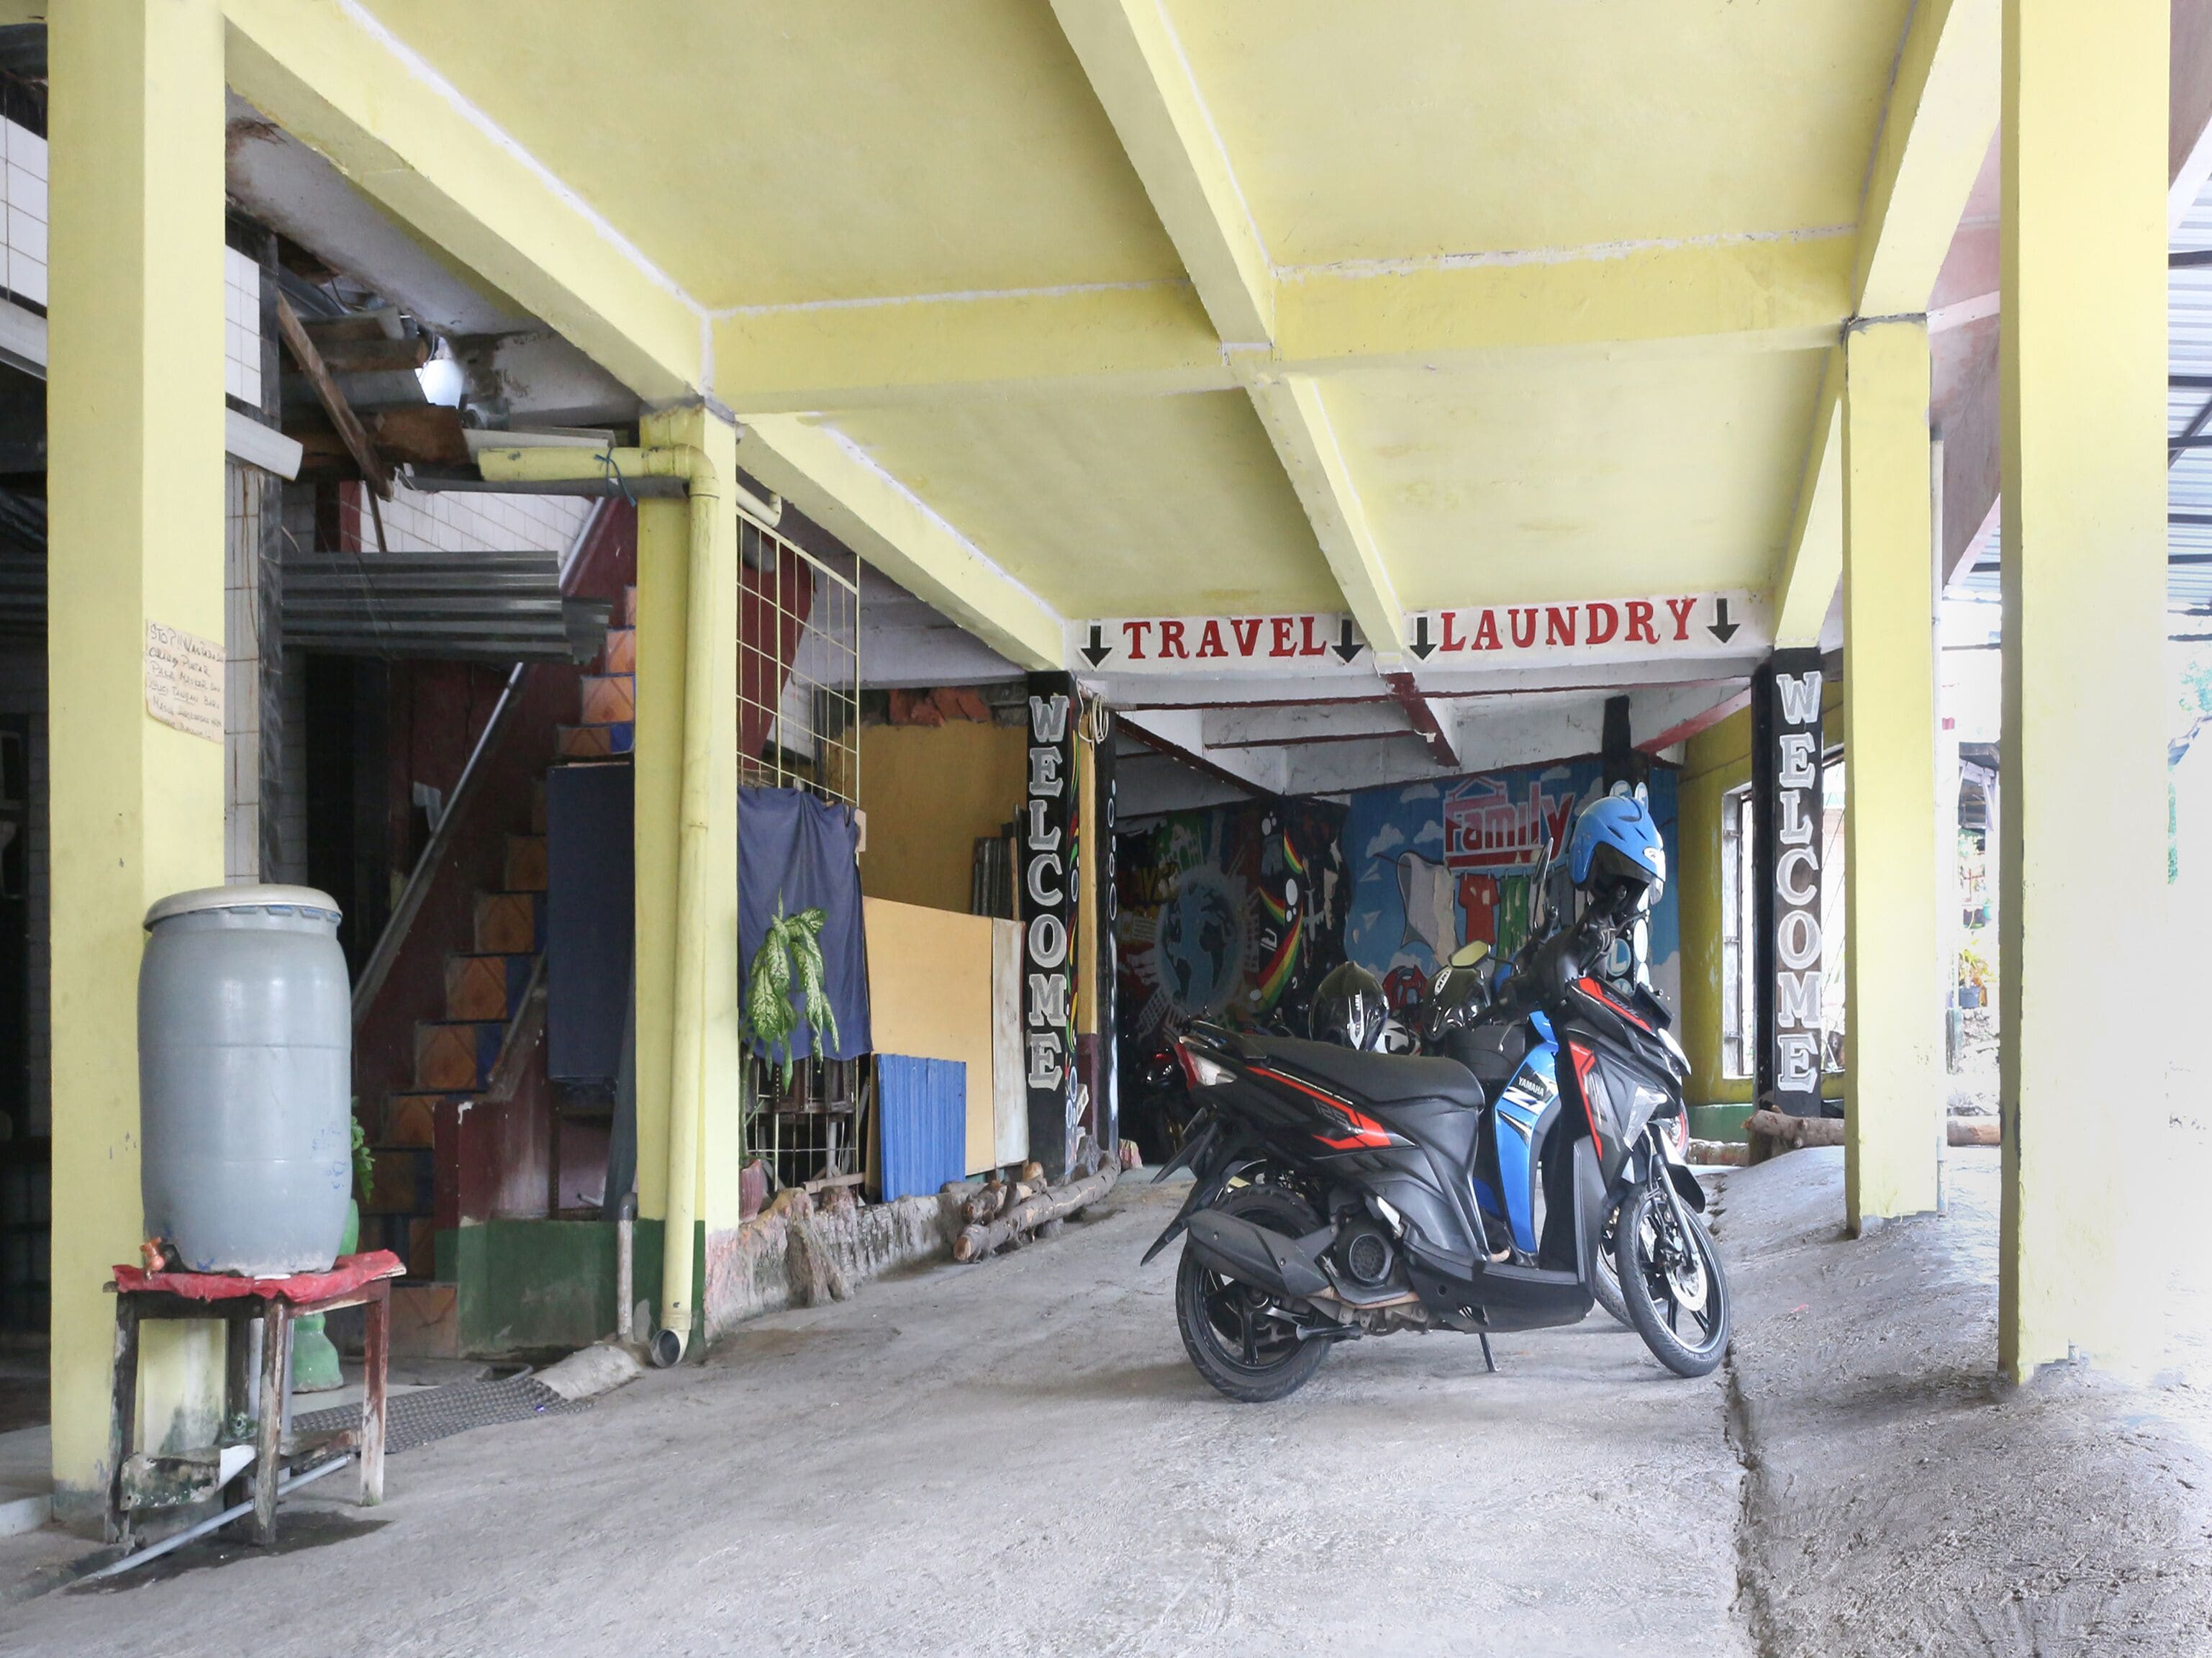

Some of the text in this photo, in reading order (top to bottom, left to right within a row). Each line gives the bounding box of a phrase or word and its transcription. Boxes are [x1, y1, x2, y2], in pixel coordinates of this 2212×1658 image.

[1123, 616, 1327, 660] TRAVEL
[1439, 598, 1697, 651] LAUNDRY
[1028, 695, 1069, 1091] WELCOME
[1777, 671, 1822, 1093] WELCOME
[1518, 1076, 1544, 1097] YAMAHA
